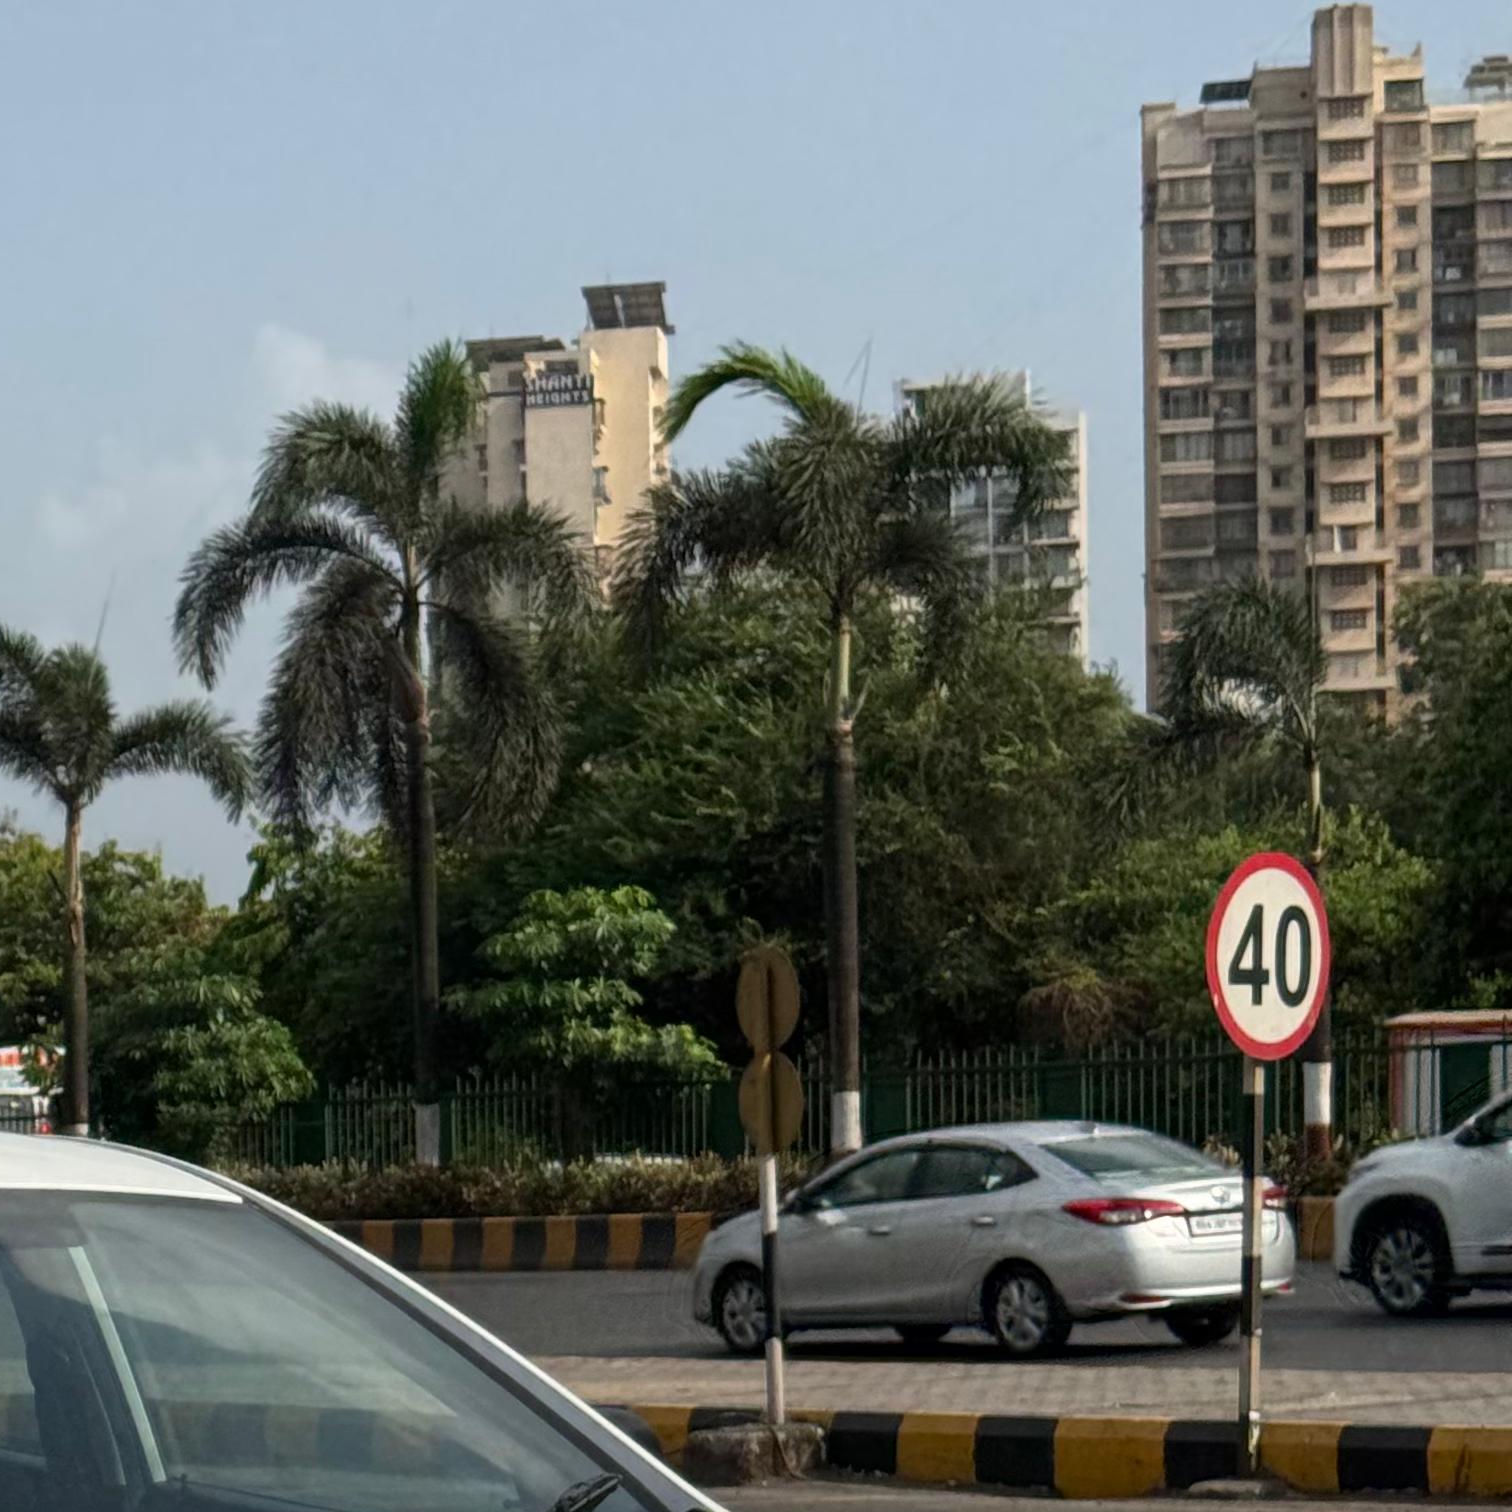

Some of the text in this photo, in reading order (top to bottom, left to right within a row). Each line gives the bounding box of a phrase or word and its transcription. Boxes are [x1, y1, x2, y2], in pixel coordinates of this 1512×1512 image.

[524, 373, 591, 392] SHANTI
[526, 390, 589, 406] HEIGHTS
[1228, 903, 1311, 1007] 40
